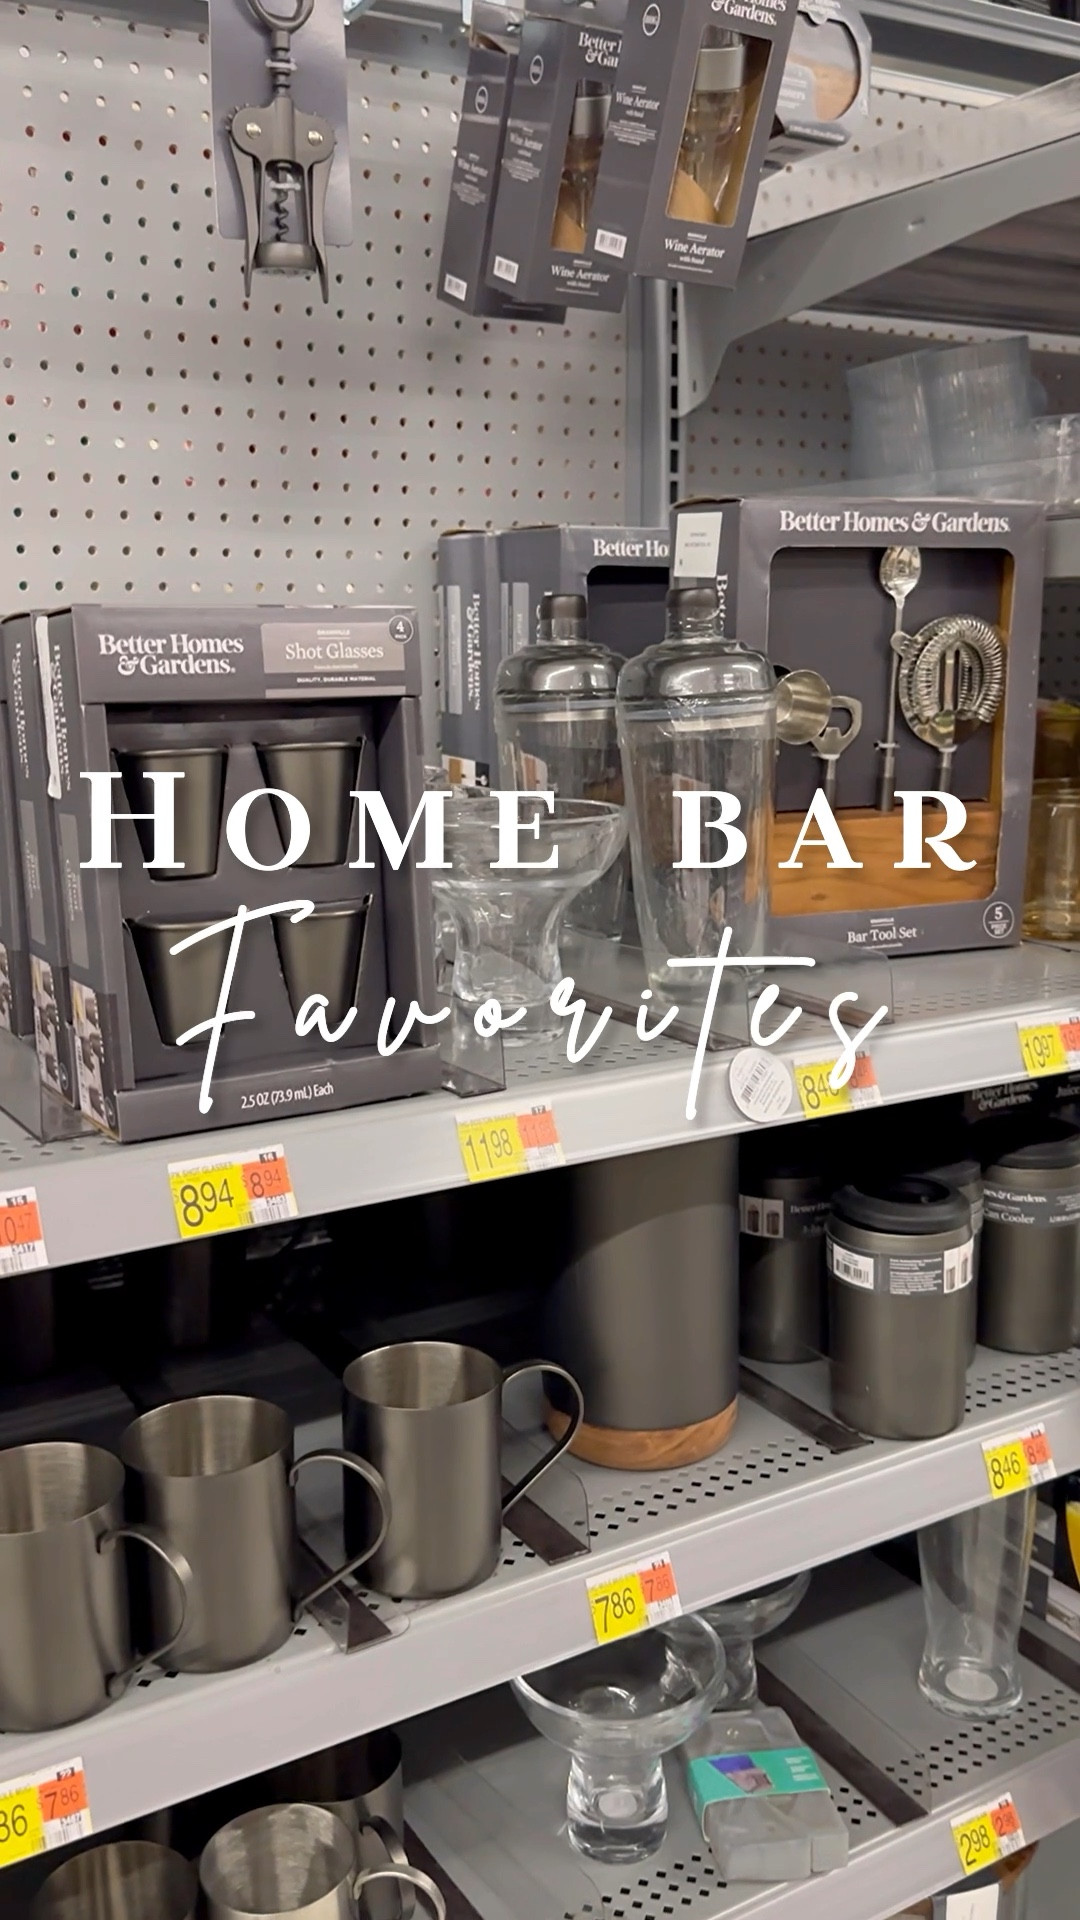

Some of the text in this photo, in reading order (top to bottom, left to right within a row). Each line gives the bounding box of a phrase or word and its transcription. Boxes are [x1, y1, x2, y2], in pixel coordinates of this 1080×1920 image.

[744, 0, 786, 12] omes
[578, 32, 617, 53] Better
[616, 91, 660, 110] Wine Aerator
[664, 238, 726, 259] Wine Aerator
[551, 265, 610, 282] Wine Aerator
[779, 510, 841, 532] Better
[843, 511, 909, 533] Homes
[592, 538, 644, 557] Better
[716, 573, 728, 632] Bette
[395, 620, 405, 633] 4
[98, 633, 244, 655] Better Homes
[285, 642, 384, 660] Shot Glasses
[994, 906, 1003, 920] 5
[847, 926, 917, 944] Bar Tool Set
[256, 1091, 270, 1107] OZ
[270, 1088, 293, 1106] (73.9
[294, 1084, 312, 1100] mL)
[313, 1081, 334, 1098] Each
[465, 1127, 513, 1172] 1198
[1000, 1211, 1036, 1225] Cooler
[990, 1451, 1021, 1490] 846
[594, 1587, 636, 1633] 786
[959, 1824, 991, 1866] 298
